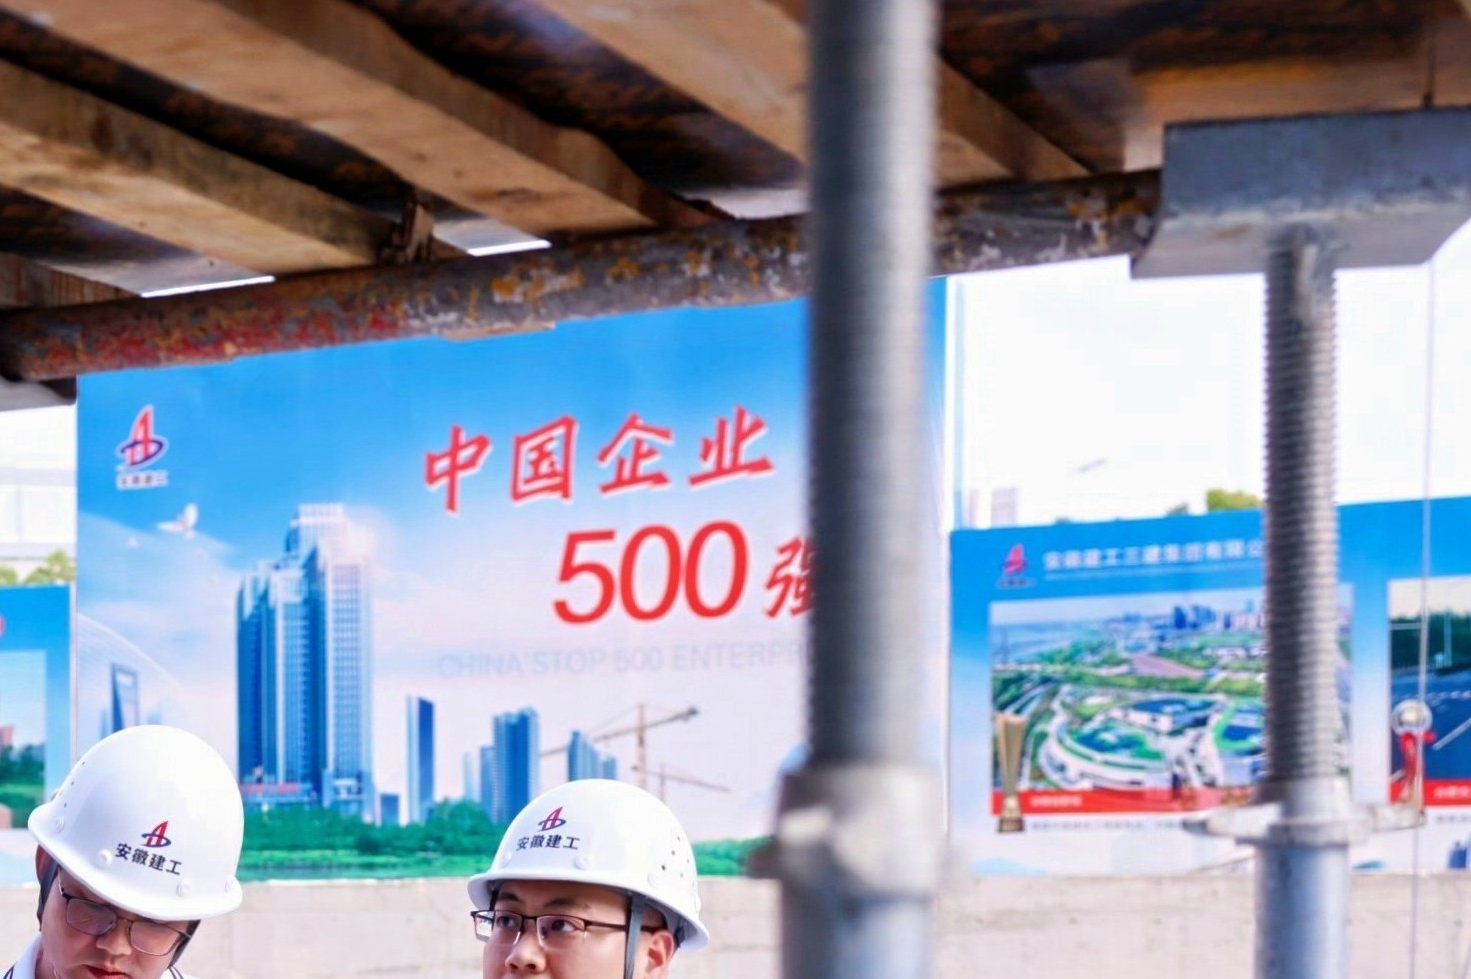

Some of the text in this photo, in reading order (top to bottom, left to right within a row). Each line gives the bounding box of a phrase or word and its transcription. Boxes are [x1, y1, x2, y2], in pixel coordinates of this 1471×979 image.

[424, 404, 775, 515] 中国企业
[613, 645, 664, 673] 500
[674, 640, 809, 671] ENTERPR
[515, 834, 581, 851] 安徽建工
[115, 843, 182, 876] 安徽建工
